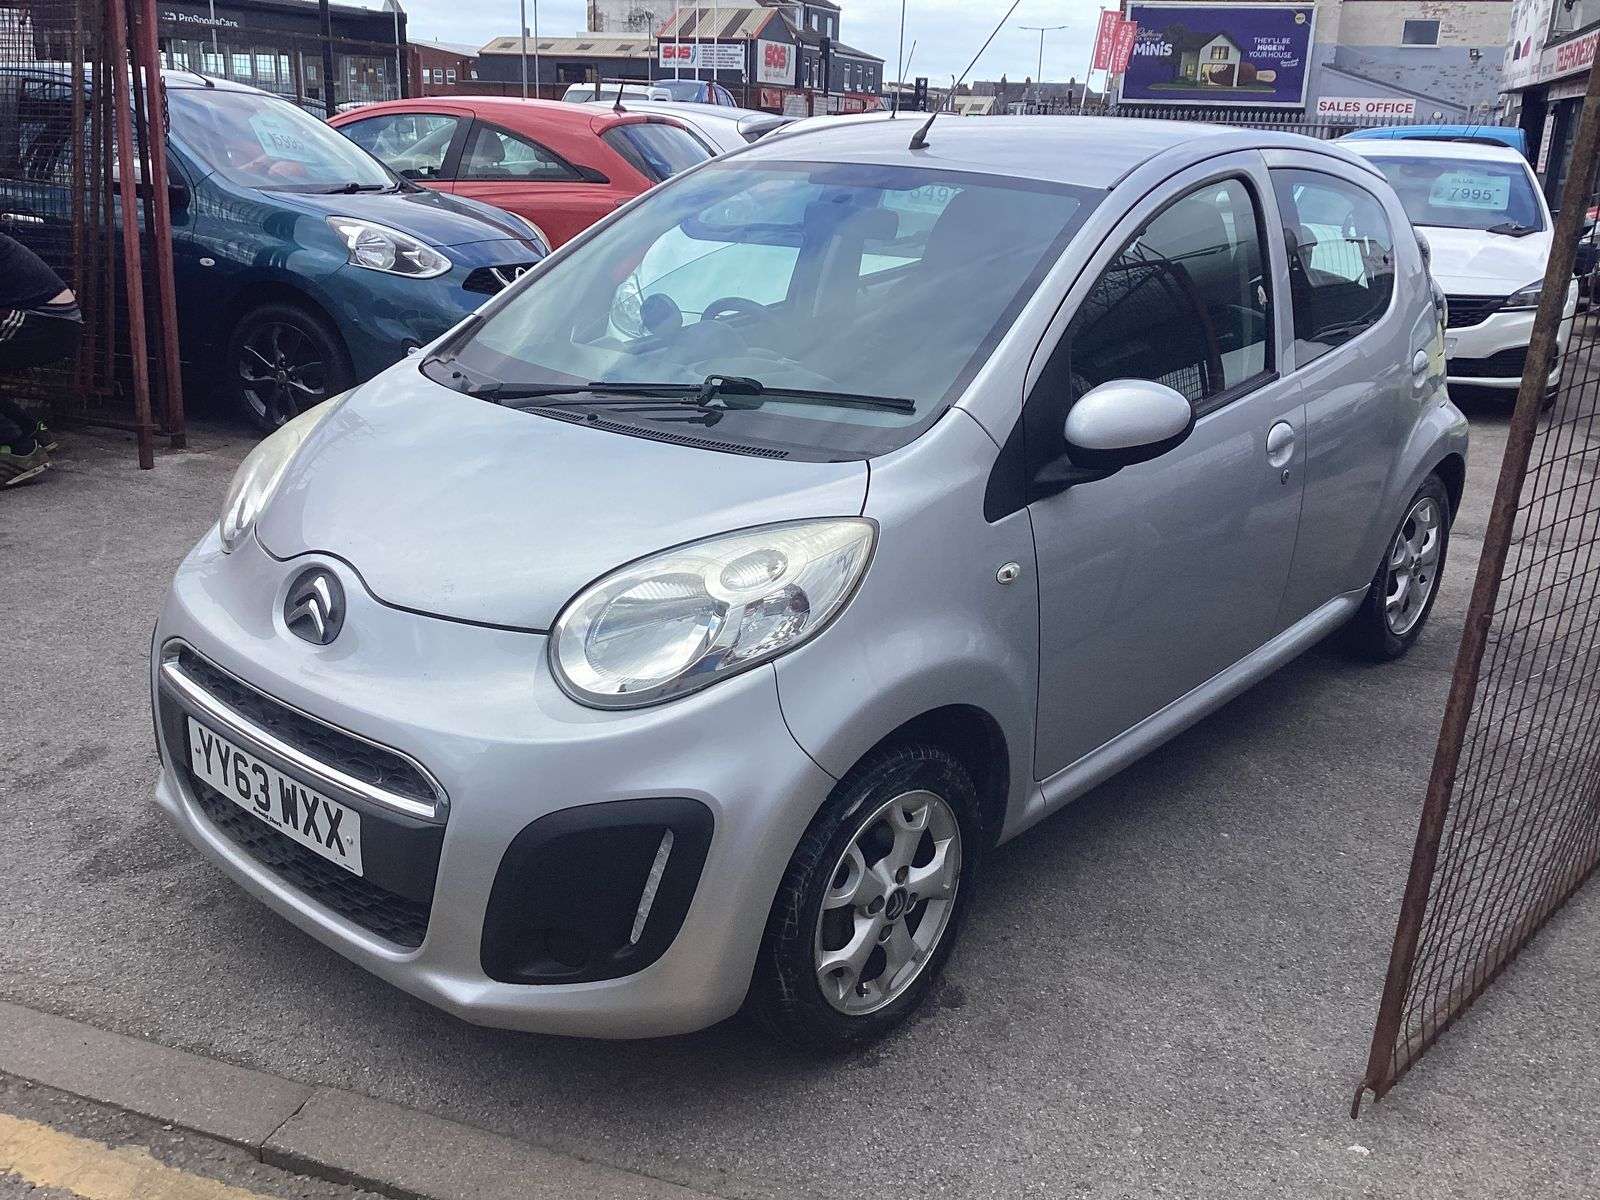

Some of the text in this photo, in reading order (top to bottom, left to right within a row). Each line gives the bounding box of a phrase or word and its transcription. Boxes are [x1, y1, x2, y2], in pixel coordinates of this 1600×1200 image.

[178, 13, 239, 28] ProSporsCars
[764, 43, 787, 69] SOS
[1319, 101, 1414, 114] SALES OFFICE
[1451, 187, 1492, 201] 7995
[199, 727, 346, 857] YY63 WXX
